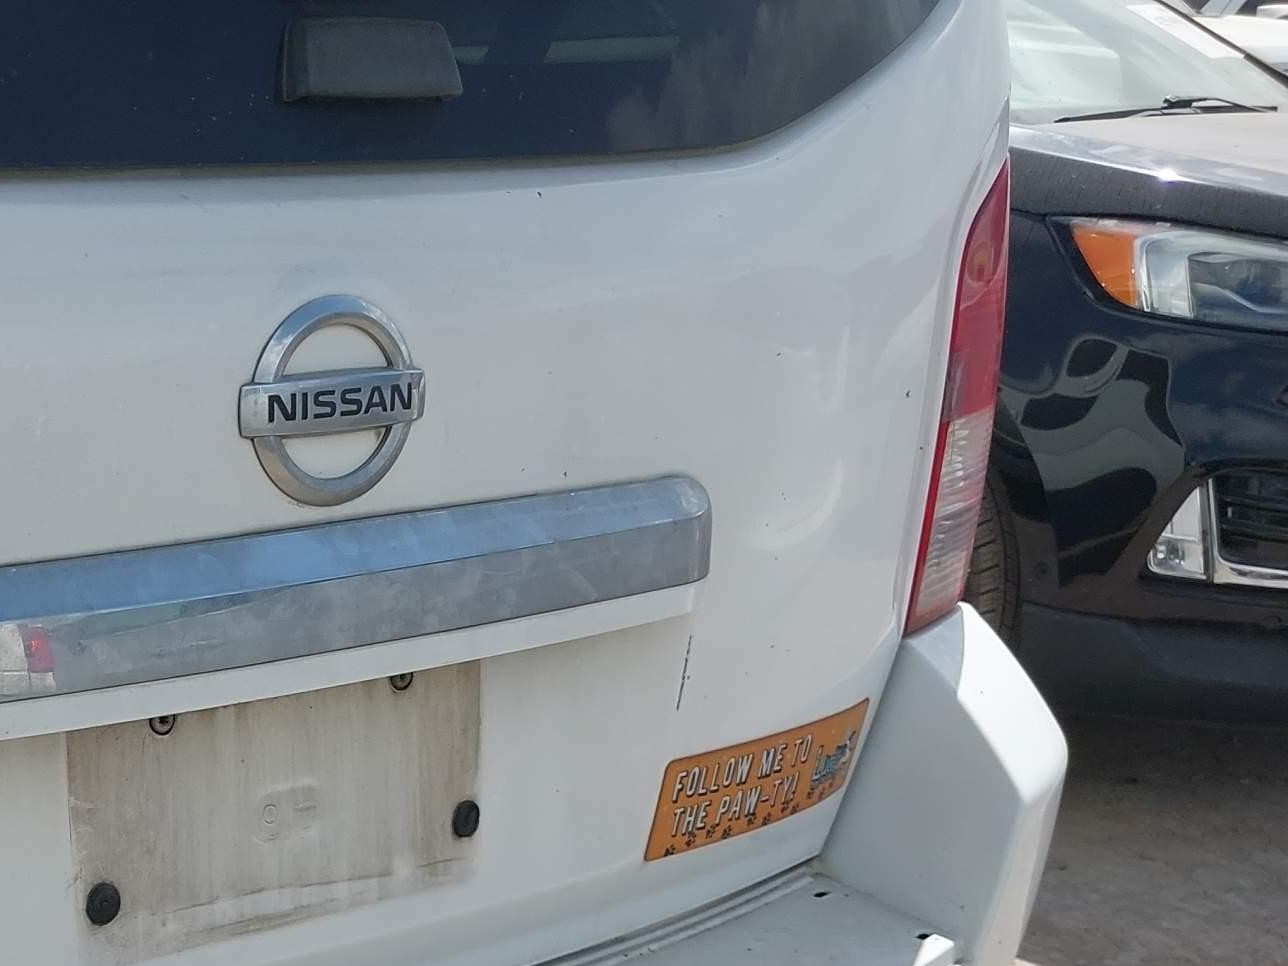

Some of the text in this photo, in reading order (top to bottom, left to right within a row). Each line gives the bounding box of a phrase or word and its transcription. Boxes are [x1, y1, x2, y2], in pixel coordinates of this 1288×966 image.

[268, 382, 412, 423] NISSAN
[671, 753, 753, 803] FOLLOW
[758, 743, 788, 779] ME
[791, 733, 813, 767] TO
[671, 771, 800, 837] THE PAW-TY!
